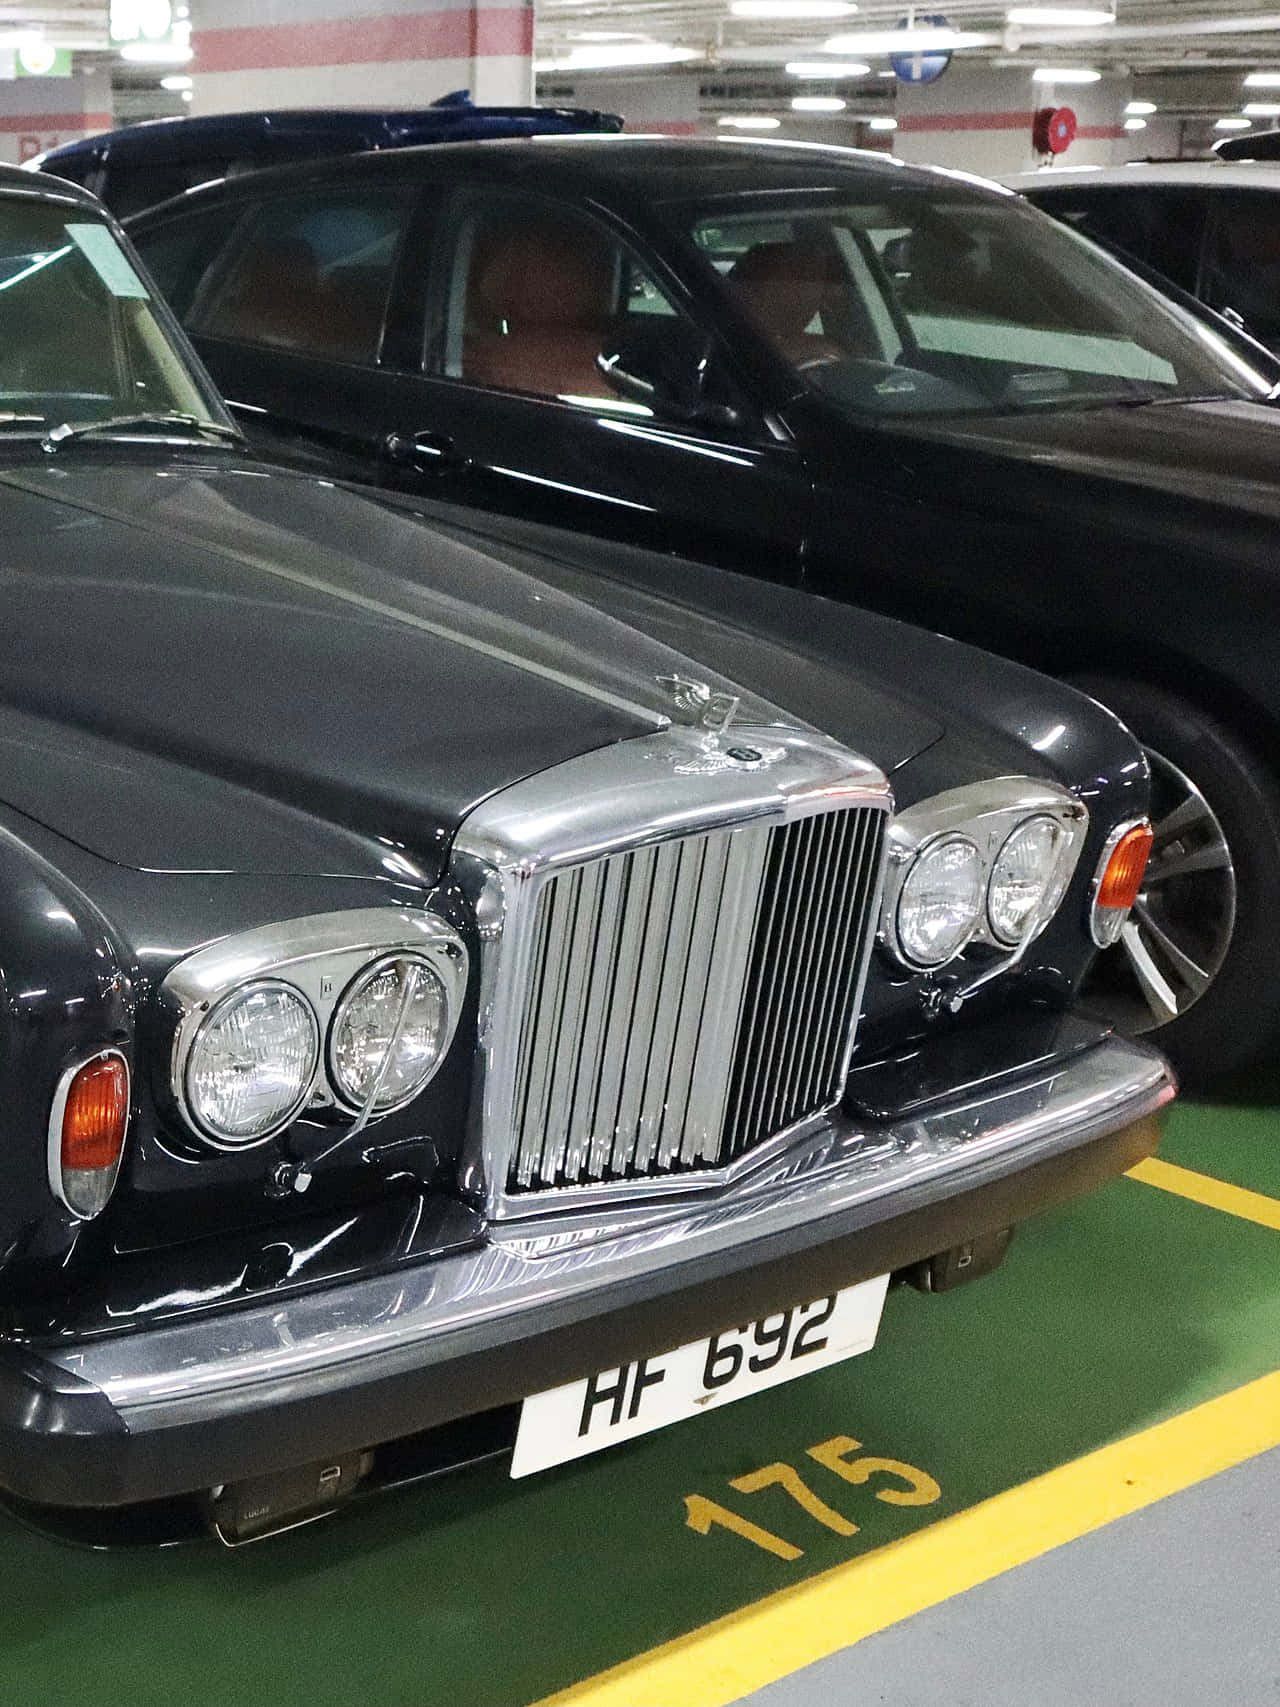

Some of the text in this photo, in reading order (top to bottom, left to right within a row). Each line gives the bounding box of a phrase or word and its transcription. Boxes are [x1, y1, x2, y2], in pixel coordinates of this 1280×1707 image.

[577, 1293, 838, 1437] HF 692
[683, 1435, 942, 1561] 175
